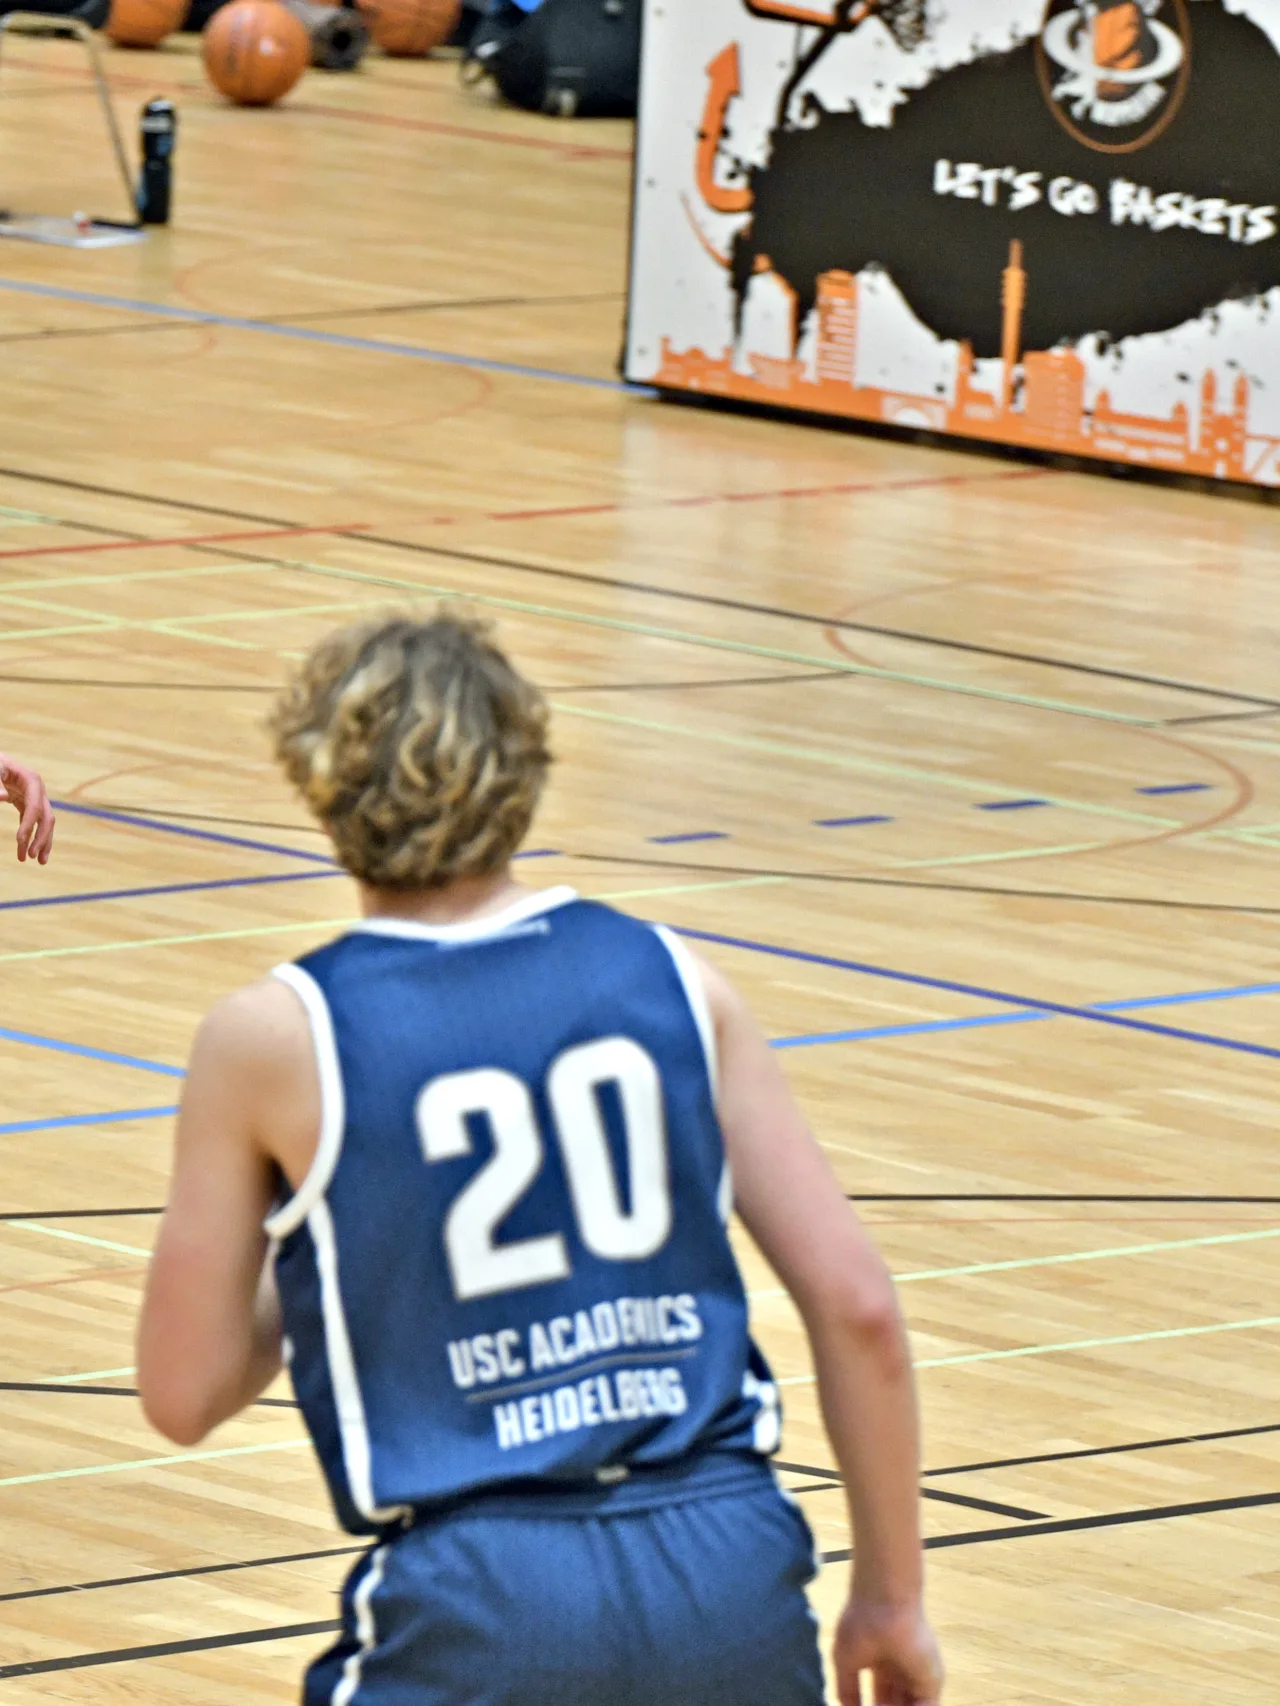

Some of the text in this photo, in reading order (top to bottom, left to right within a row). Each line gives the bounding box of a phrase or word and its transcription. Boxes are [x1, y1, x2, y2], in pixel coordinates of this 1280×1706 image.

[933, 158, 1278, 246] LET'S GO BASKETS
[415, 1035, 672, 1301] 20
[447, 1329, 525, 1389] USC
